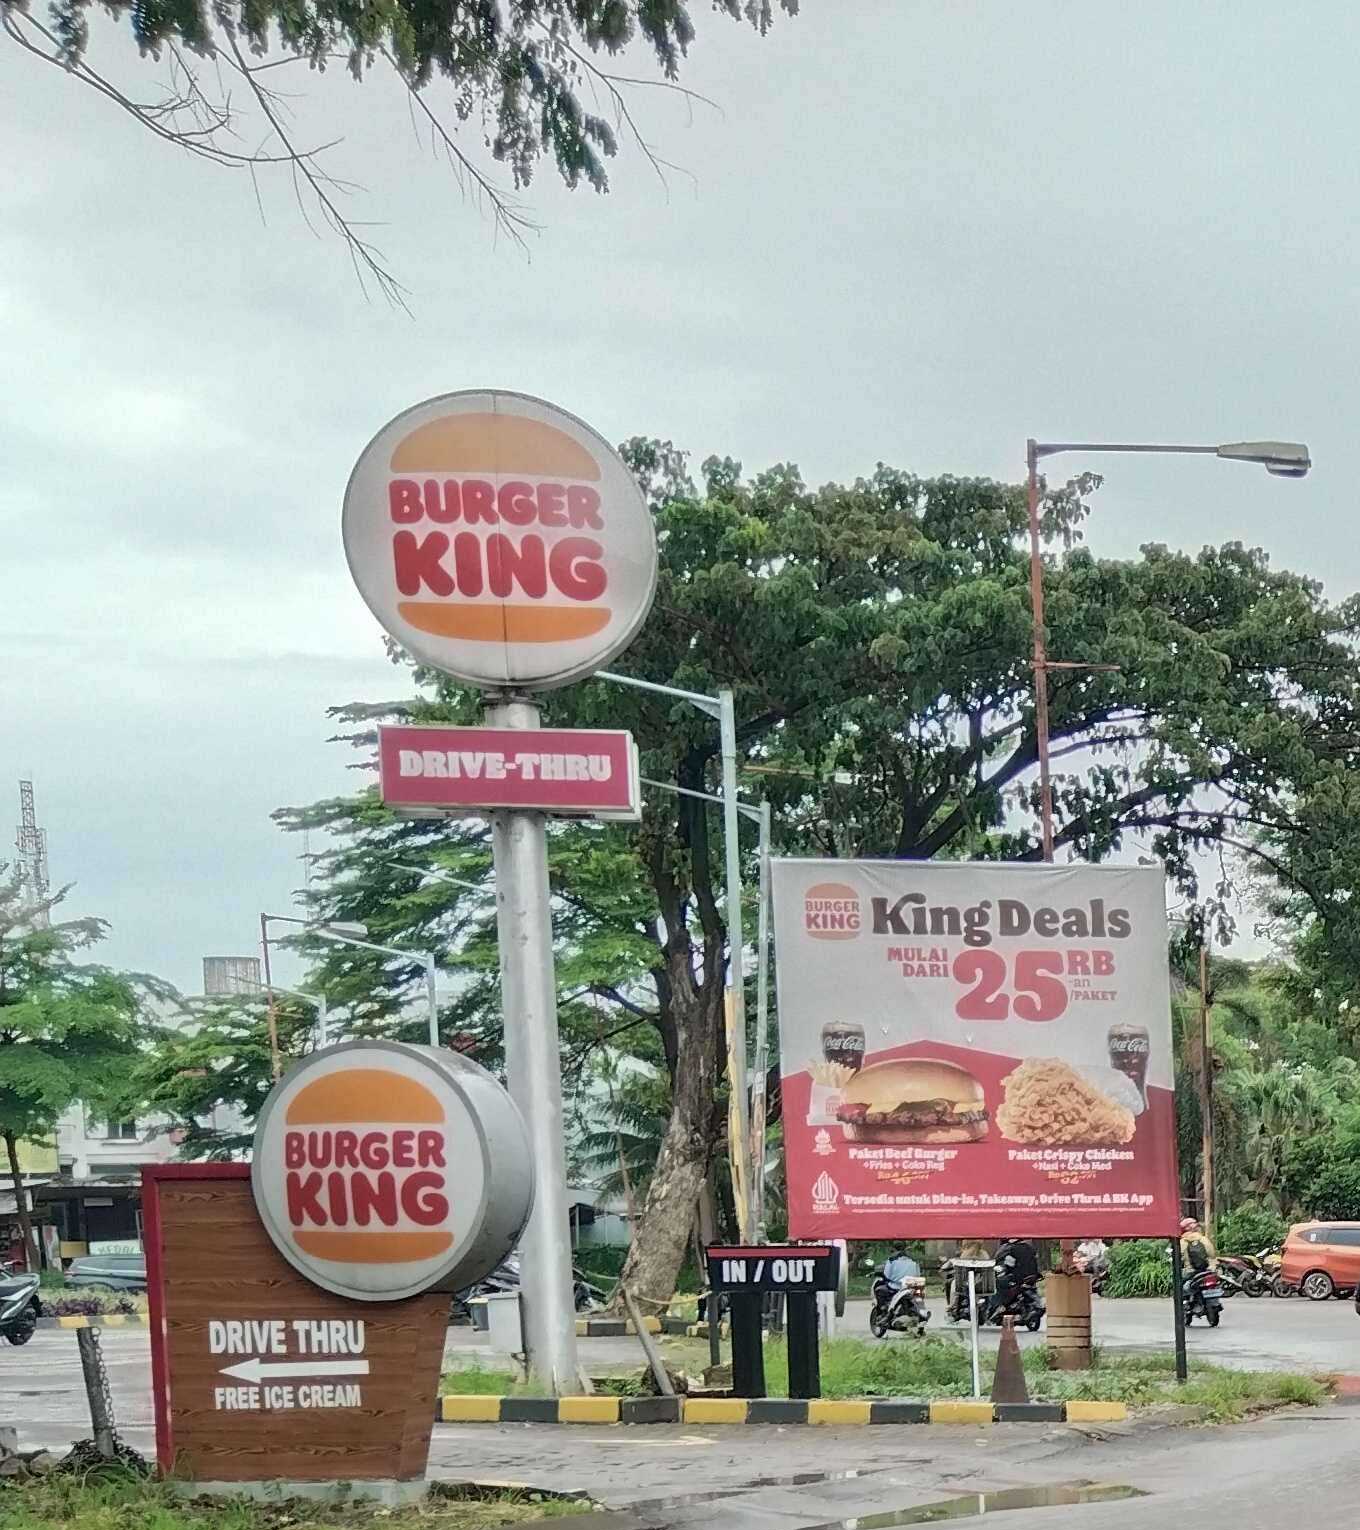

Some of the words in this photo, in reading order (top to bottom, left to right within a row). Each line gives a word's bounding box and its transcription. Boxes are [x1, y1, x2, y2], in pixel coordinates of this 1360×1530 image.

[388, 478, 605, 530] BURGER
[392, 530, 609, 601] KING
[398, 750, 612, 781] DRIVE-THRU
[805, 900, 860, 913] BURGER
[870, 892, 993, 947] King
[997, 898, 1132, 939] Deals
[806, 913, 861, 930] KING
[887, 947, 949, 962] MULAI
[1066, 950, 1116, 976] RB
[902, 963, 950, 978] DARI
[952, 948, 1069, 1023] 25
[285, 1130, 447, 1170] BURGER
[848, 1148, 884, 1160] Paket
[885, 1147, 913, 1160] Beef
[914, 1148, 958, 1163] Burger
[1008, 1149, 1044, 1161] Paket
[1045, 1149, 1084, 1163] Crispy
[1085, 1148, 1134, 1161] Chicken
[286, 1170, 450, 1227] KING
[843, 1193, 895, 1205] Tersedia
[895, 1193, 930, 1205] untuk
[1040, 1193, 1071, 1204] Drive
[1072, 1193, 1101, 1204] Thru
[1102, 1194, 1112, 1204] &
[1131, 1194, 1153, 1206] App
[722, 1260, 747, 1283] IN
[753, 1260, 765, 1283] /
[772, 1259, 816, 1283] OUT
[208, 1321, 286, 1354] DRIVE
[293, 1320, 365, 1354] THRU
[214, 1386, 260, 1410] FREE
[264, 1386, 295, 1409] ICE
[298, 1384, 362, 1408] CREAM
